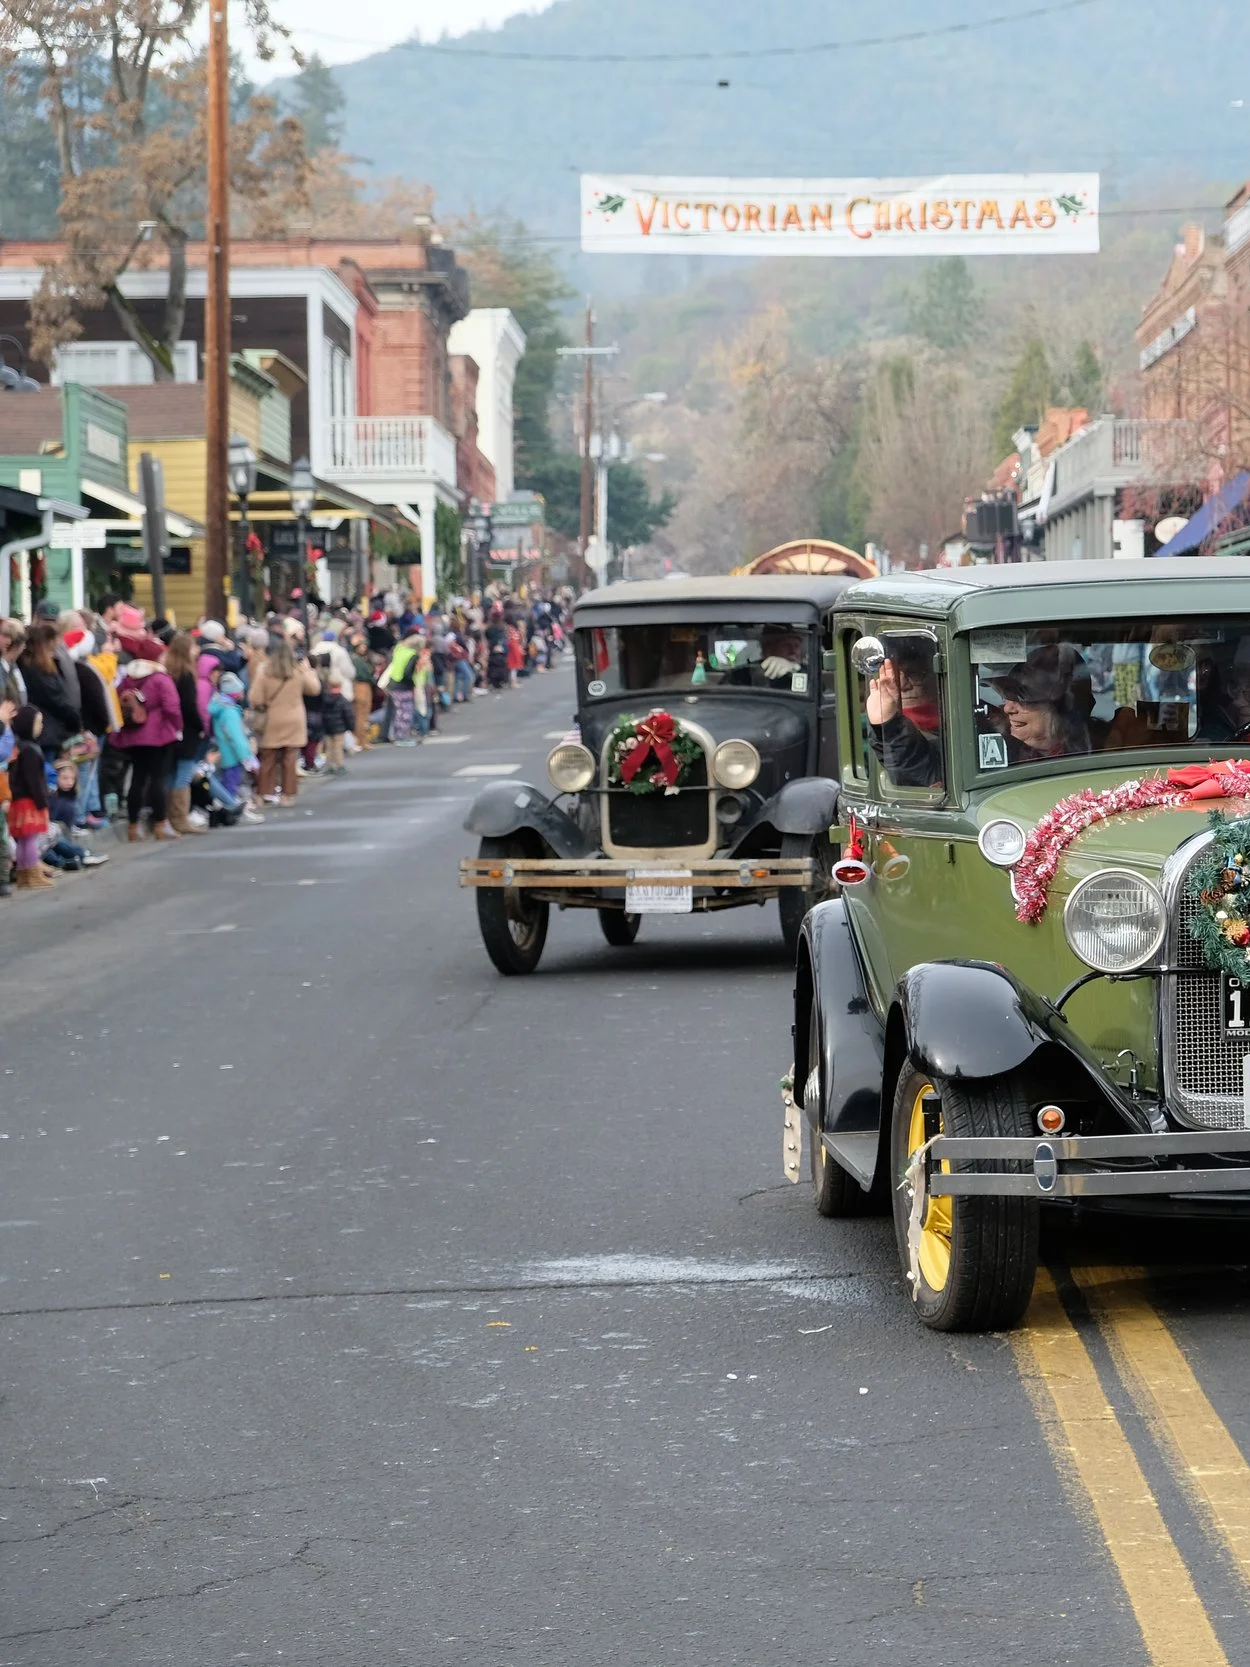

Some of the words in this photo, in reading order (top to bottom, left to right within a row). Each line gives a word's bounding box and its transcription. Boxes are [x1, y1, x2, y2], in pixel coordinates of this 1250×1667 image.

[633, 195, 834, 236] VICTORIAN
[844, 197, 1057, 240] CHRISTMAS
[984, 739, 1003, 762] A
